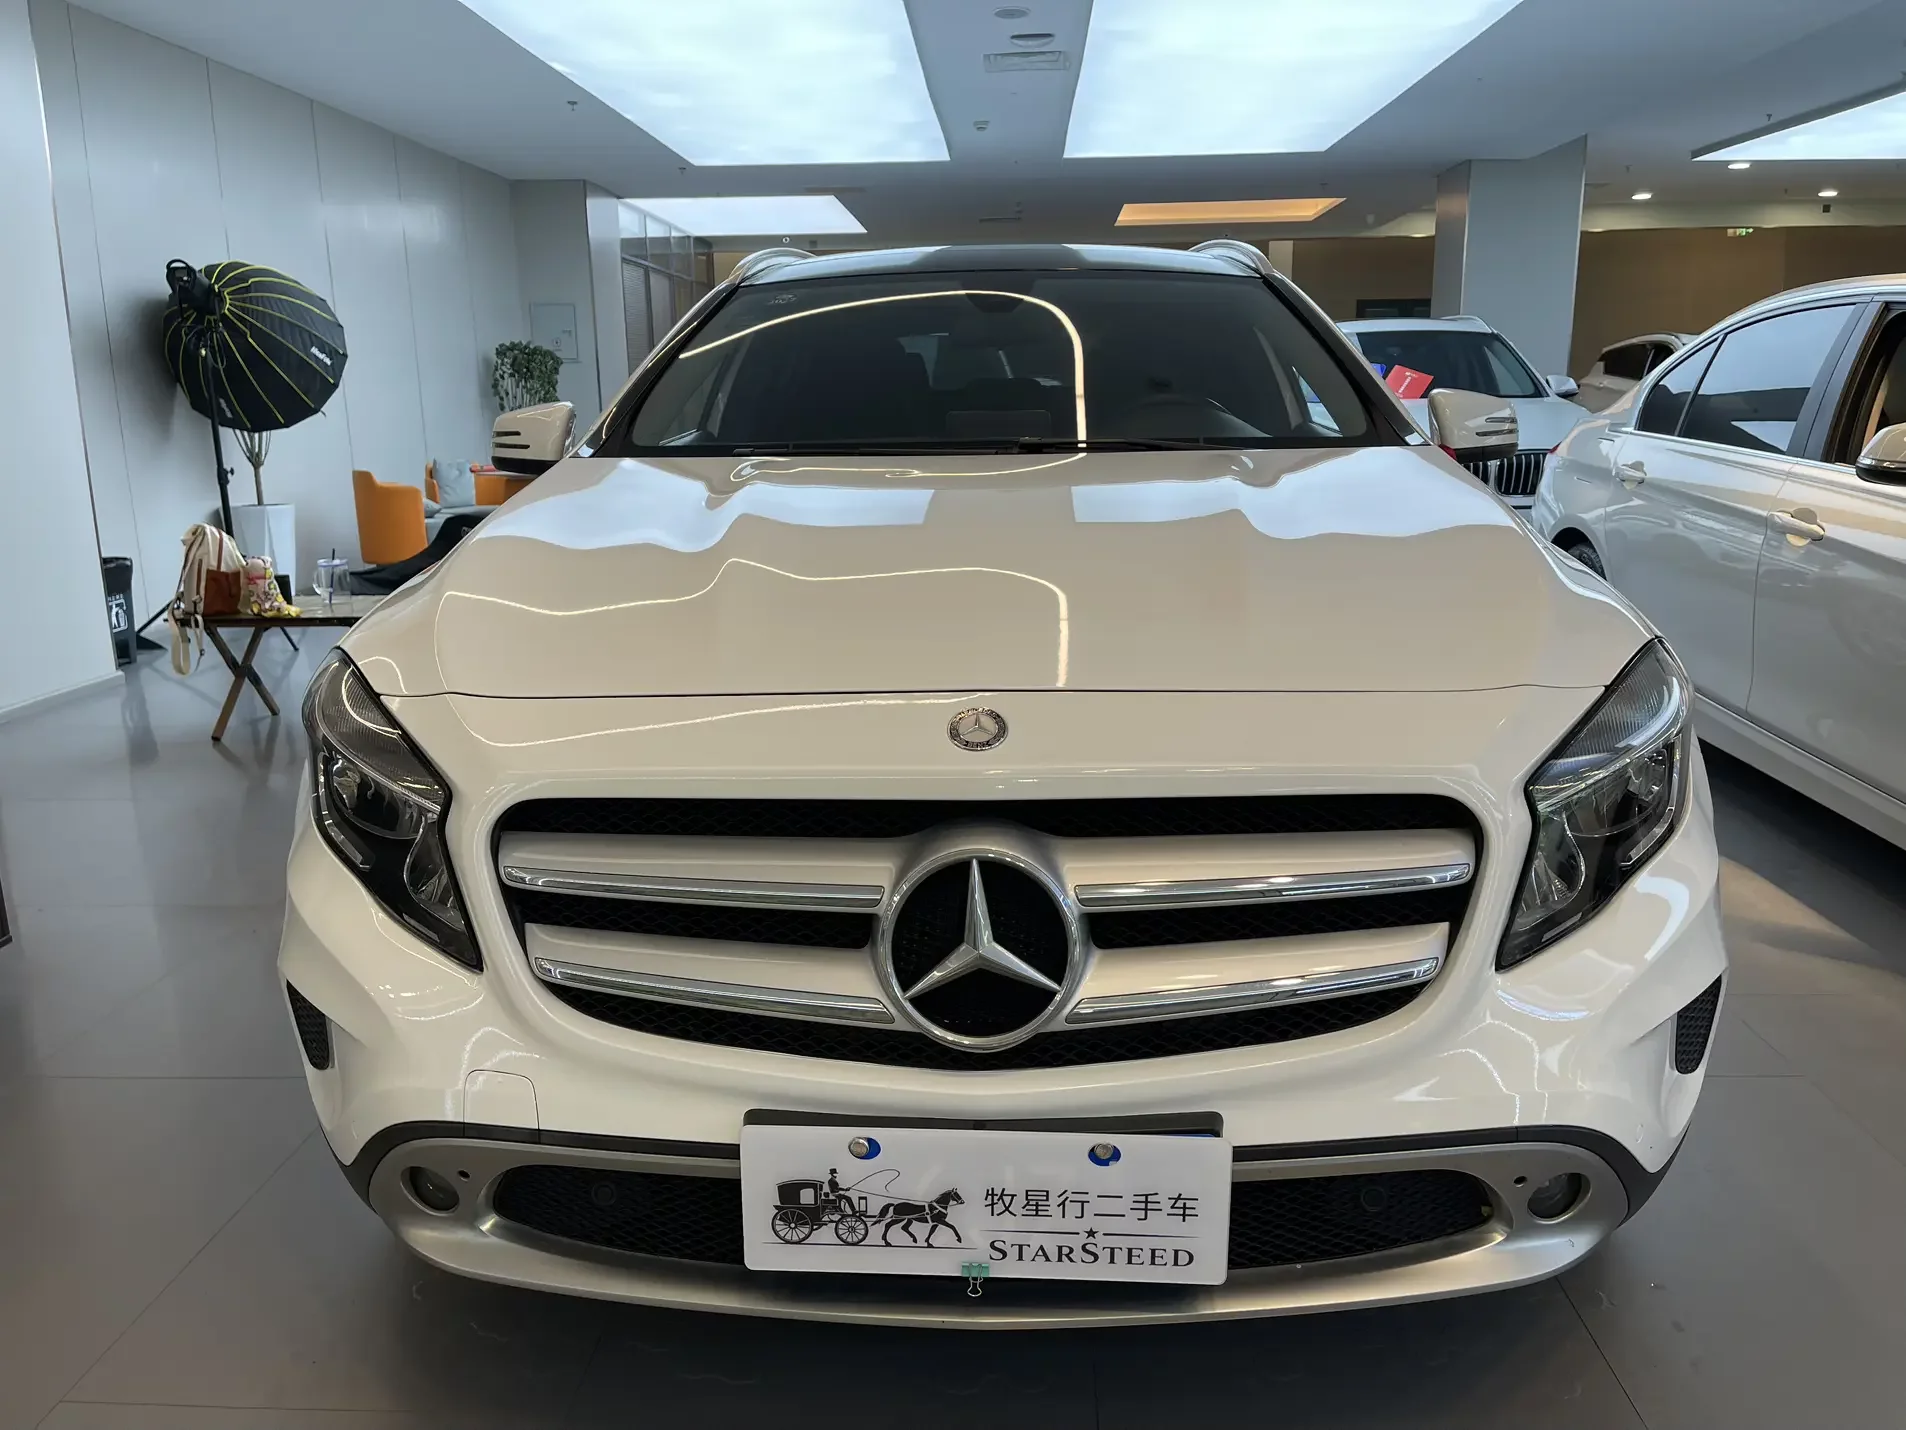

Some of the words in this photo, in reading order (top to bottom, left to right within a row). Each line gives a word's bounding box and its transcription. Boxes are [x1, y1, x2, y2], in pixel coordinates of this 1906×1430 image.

[984, 1187, 1199, 1222] 牧星行二手车
